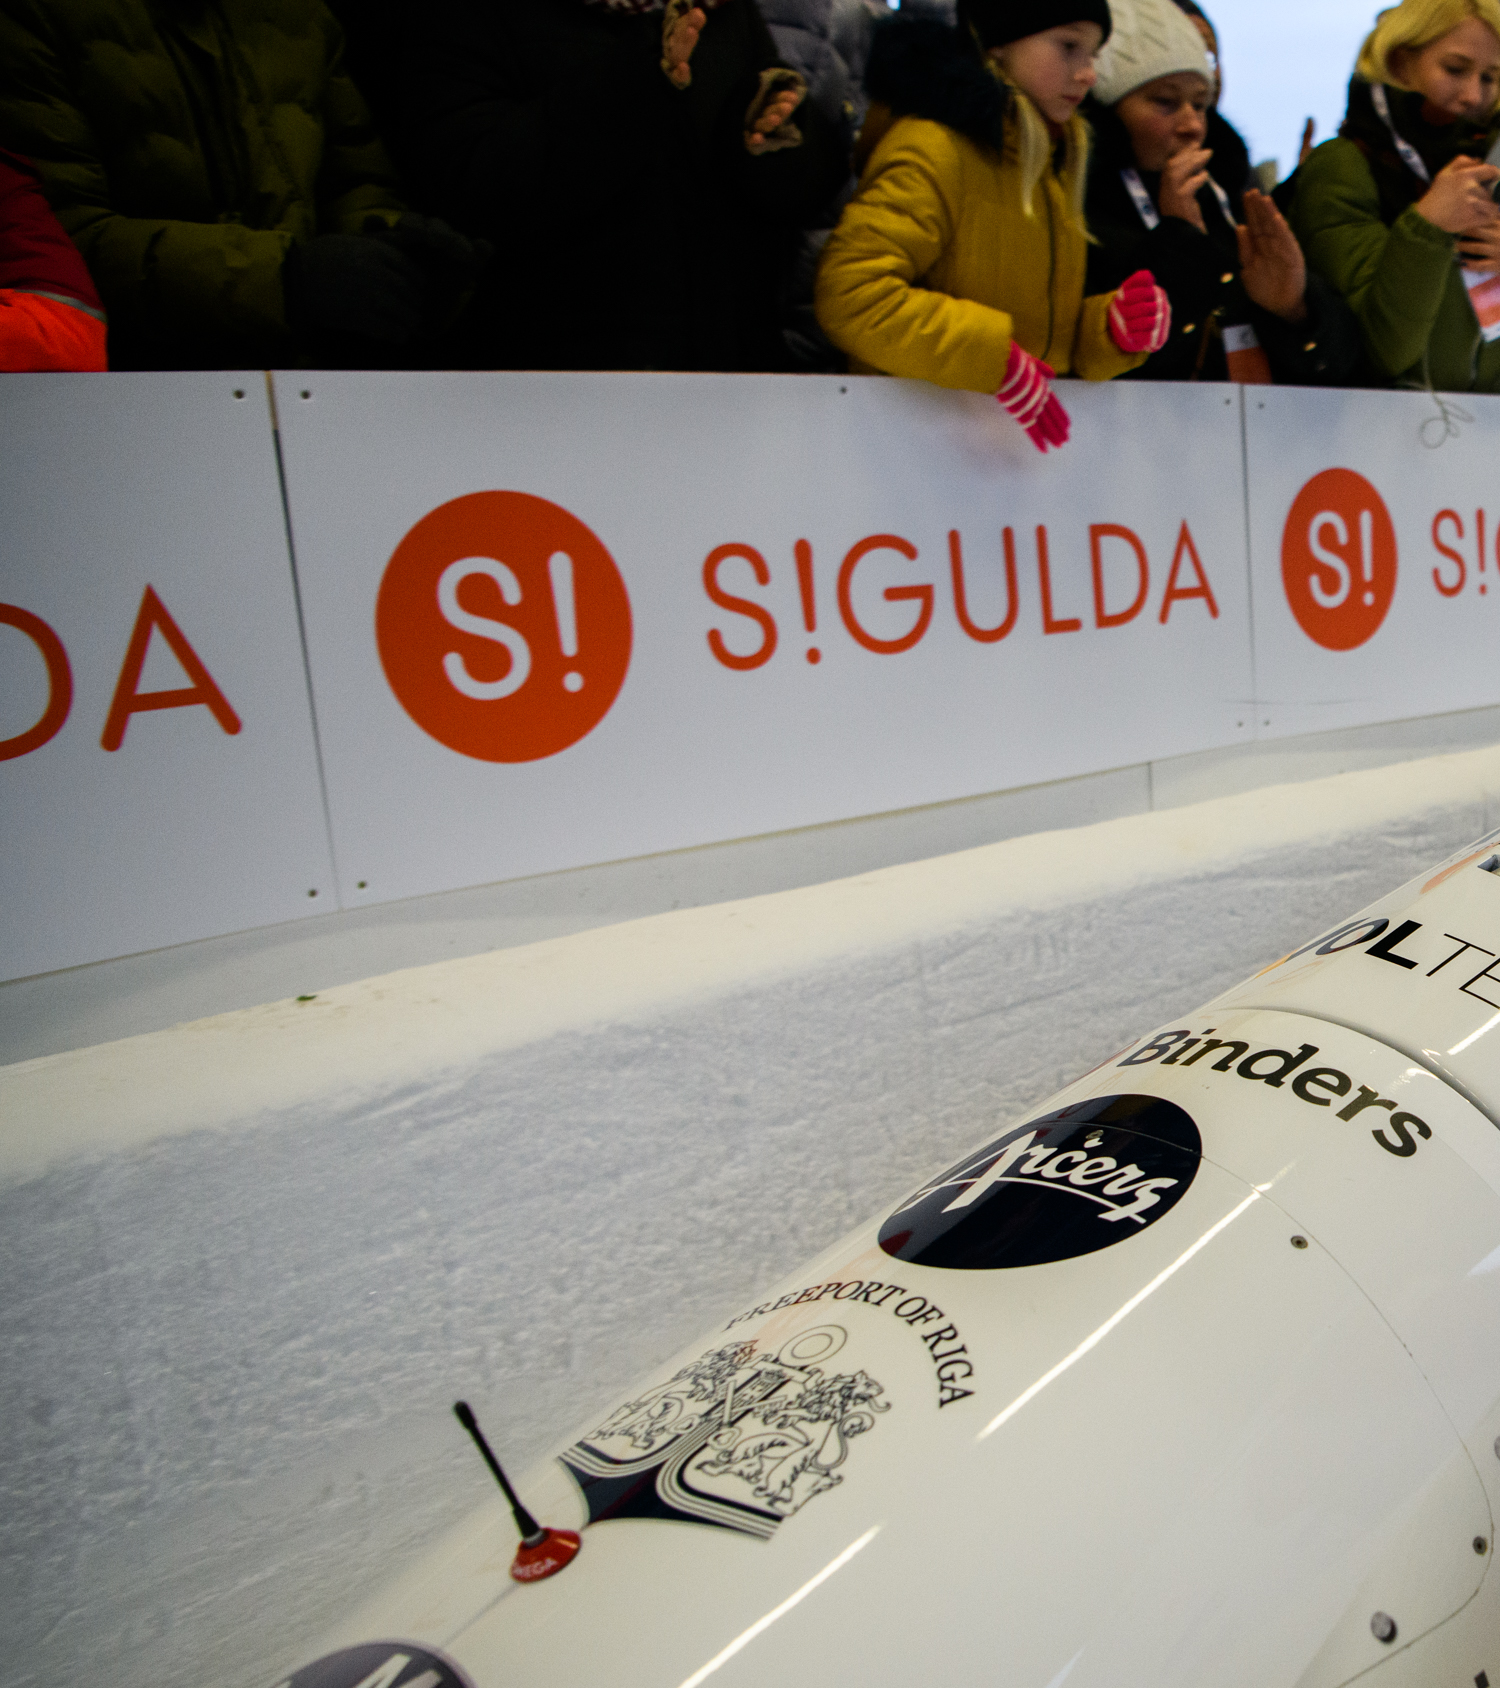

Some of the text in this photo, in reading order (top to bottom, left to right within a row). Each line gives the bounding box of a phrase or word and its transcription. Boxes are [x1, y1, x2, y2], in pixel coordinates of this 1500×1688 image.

[702, 519, 1221, 671] S!GULDA
[1116, 1028, 1433, 1158] Binders
[722, 1280, 975, 1409] FREEPORT OF RIGA
